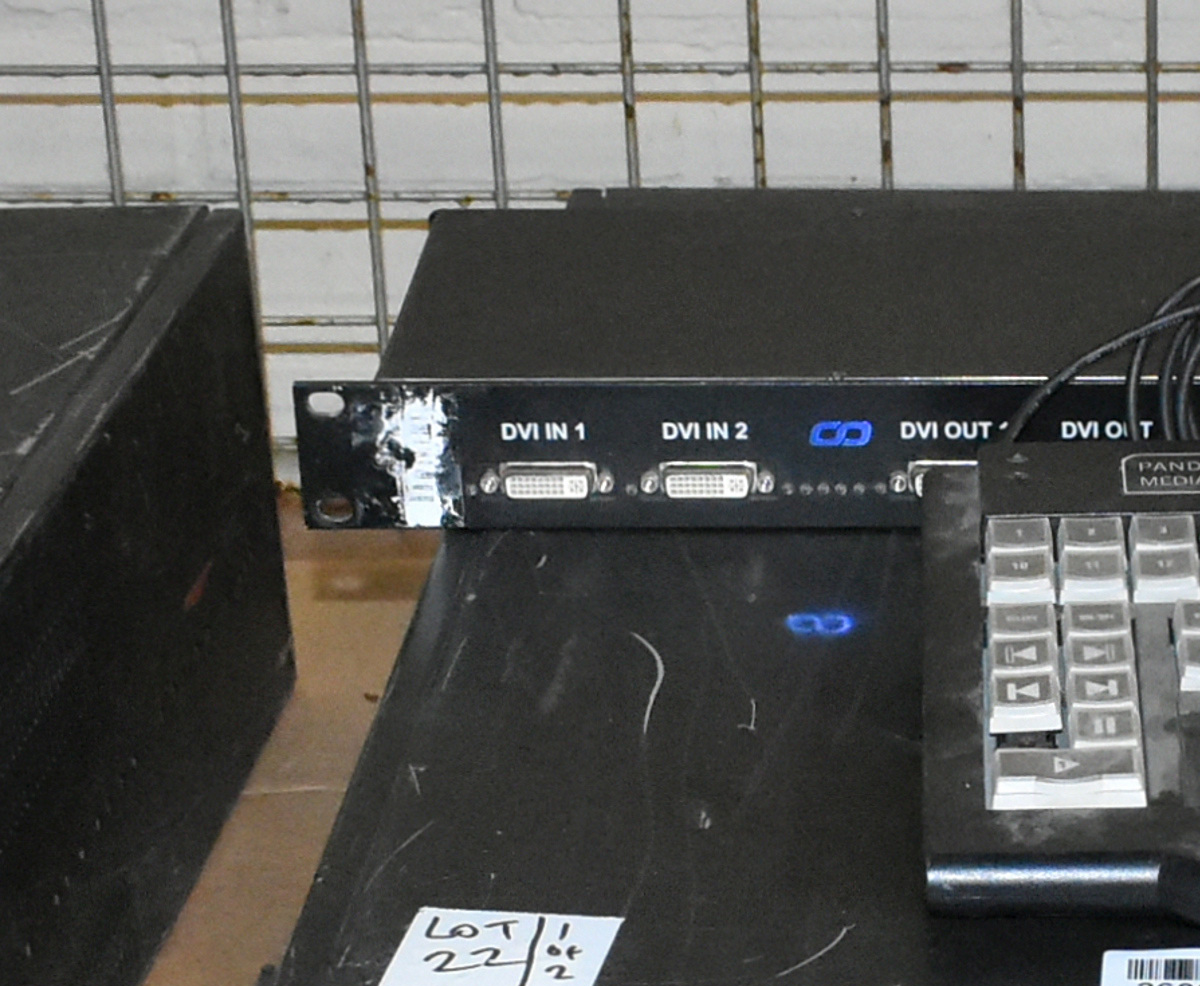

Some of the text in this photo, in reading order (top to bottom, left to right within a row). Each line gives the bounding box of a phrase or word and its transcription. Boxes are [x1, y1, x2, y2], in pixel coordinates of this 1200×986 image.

[500, 421, 586, 440] DVI IN 1
[662, 421, 749, 440] DVI IN 2
[900, 421, 939, 440] DVI
[944, 421, 992, 440] OUT
[1061, 421, 1154, 439] DVI OT
[424, 915, 520, 940] LOT
[423, 947, 527, 973] 22
[544, 964, 575, 980] 2
